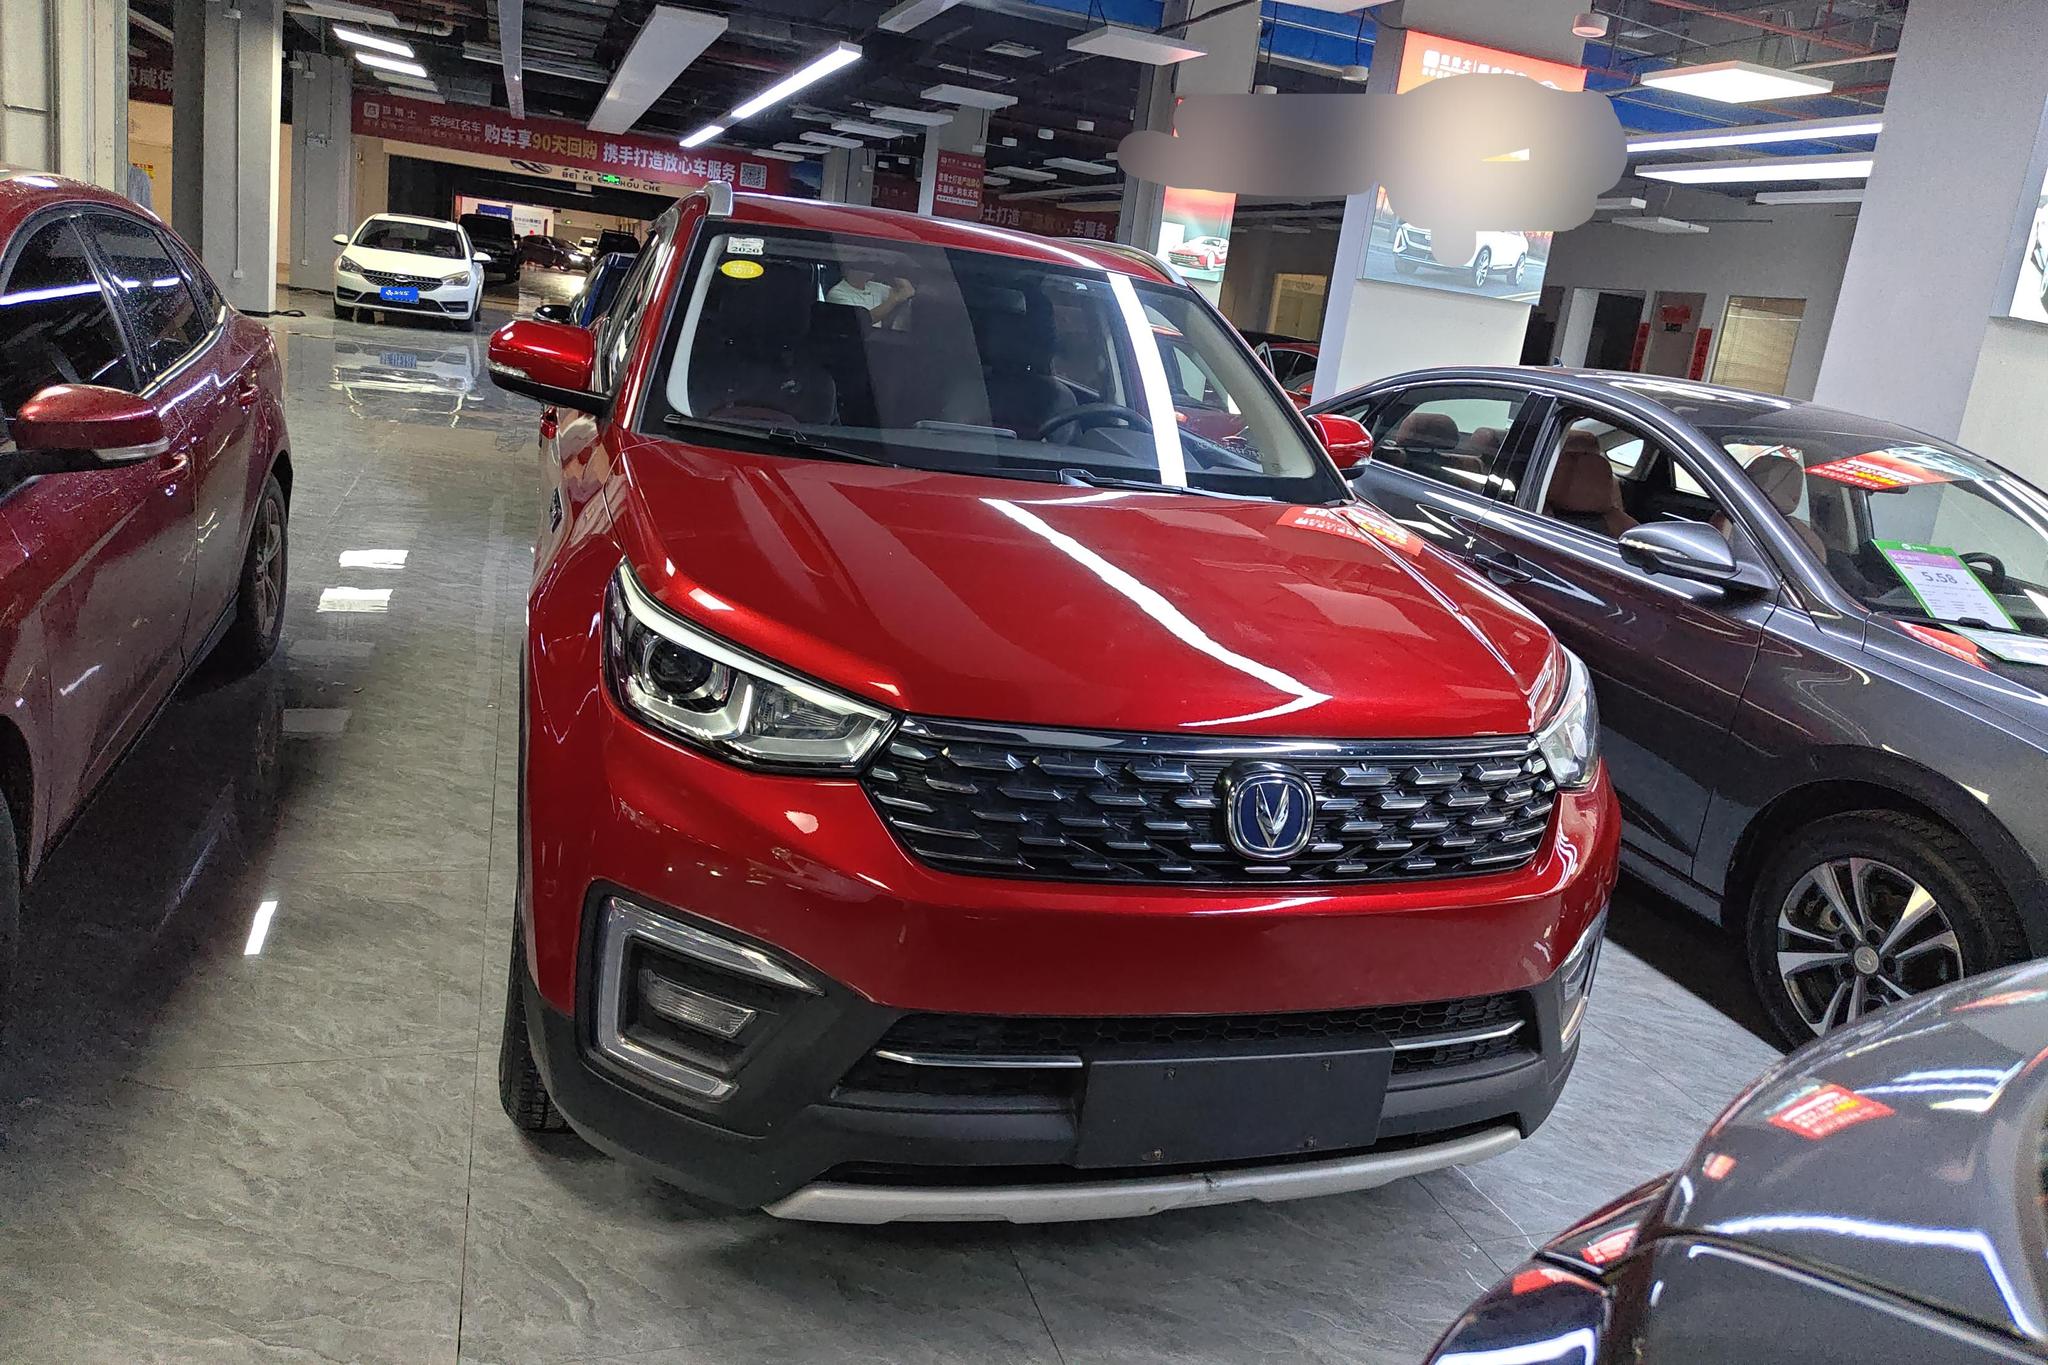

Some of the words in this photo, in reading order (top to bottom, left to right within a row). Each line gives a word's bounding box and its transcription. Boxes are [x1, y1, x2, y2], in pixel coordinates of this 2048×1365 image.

[484, 123, 598, 160] 购车享90天回购
[602, 142, 736, 182] 携手打造放心车服务
[562, 171, 578, 181] BEI
[583, 173, 594, 182] KE
[642, 184, 661, 193] CHE
[730, 246, 760, 255] 2020
[1920, 571, 1958, 584] 5.58
